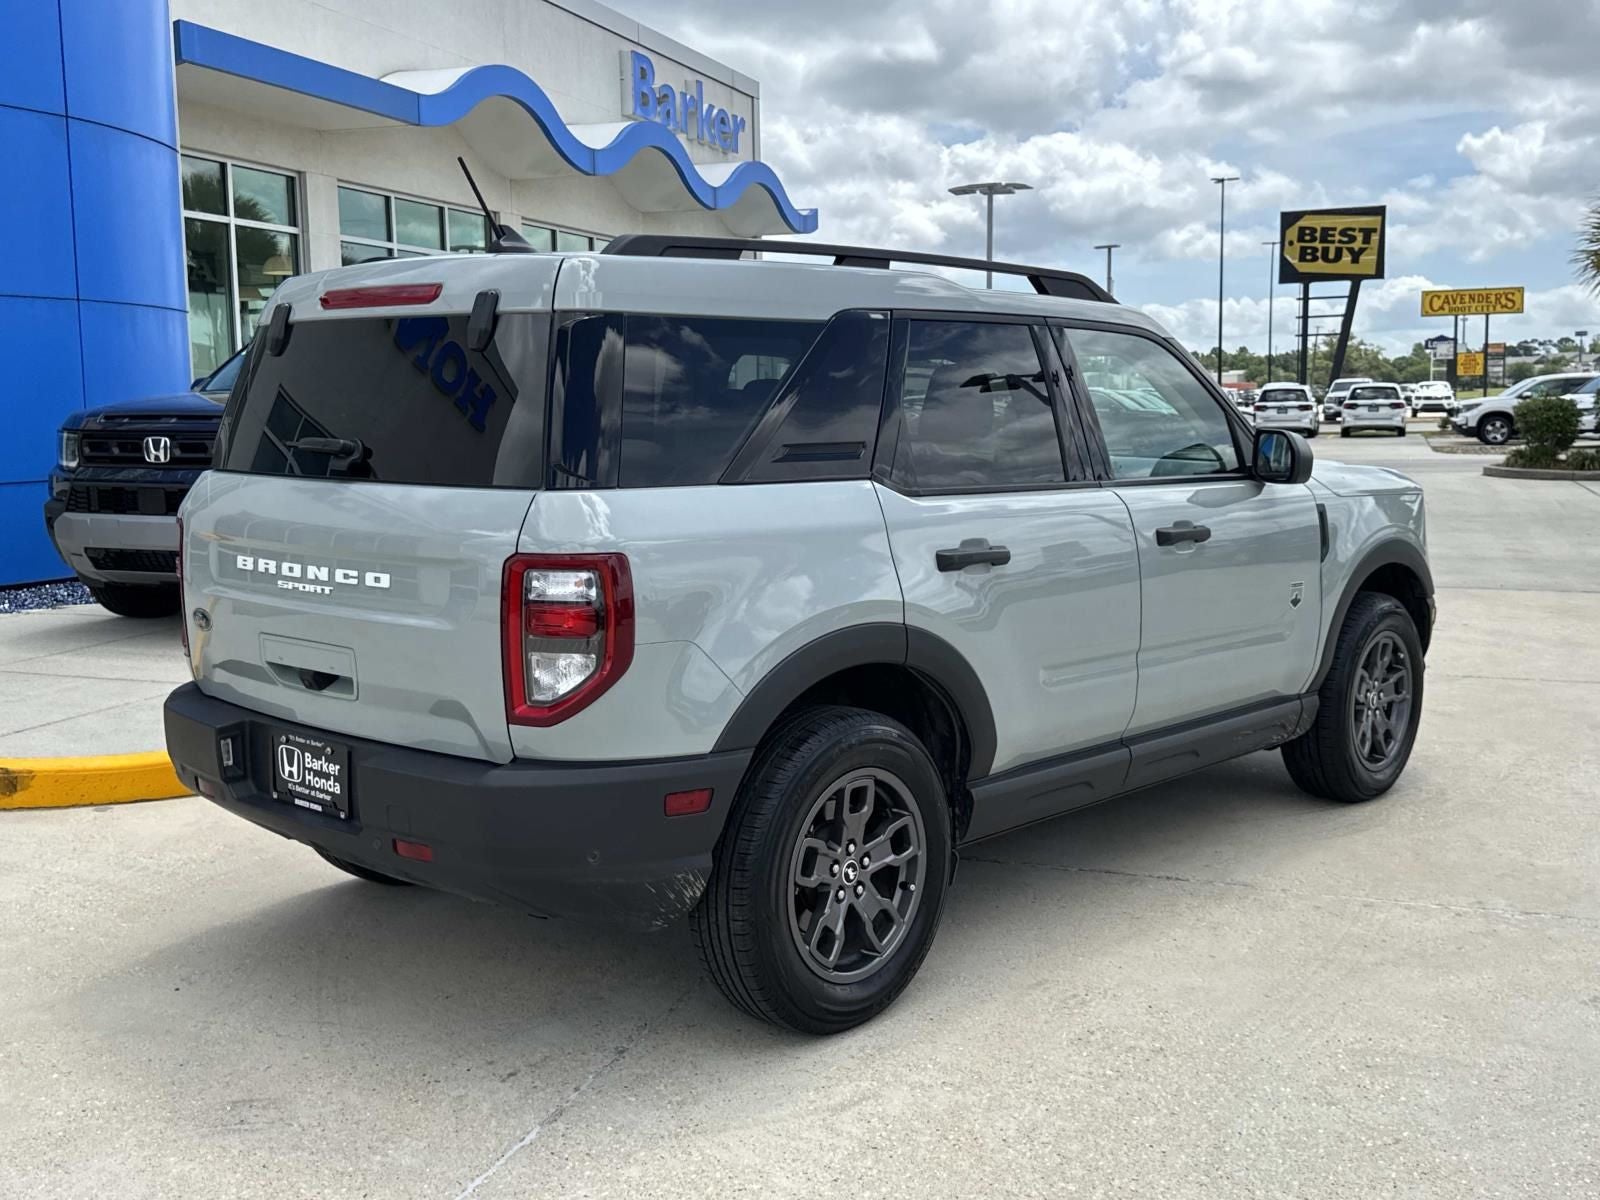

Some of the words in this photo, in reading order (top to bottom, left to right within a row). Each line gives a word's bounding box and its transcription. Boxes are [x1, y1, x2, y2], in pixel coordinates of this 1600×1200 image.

[630, 50, 746, 153] Barker
[1297, 226, 1377, 245] BEST
[1298, 245, 1369, 264] BUY
[1429, 291, 1516, 312] CAVENDER'S
[1474, 304, 1497, 312] CITY
[236, 555, 390, 588] BRONCO
[277, 580, 334, 594] SPORT
[304, 751, 341, 776] Barker
[305, 769, 341, 794] Honda
